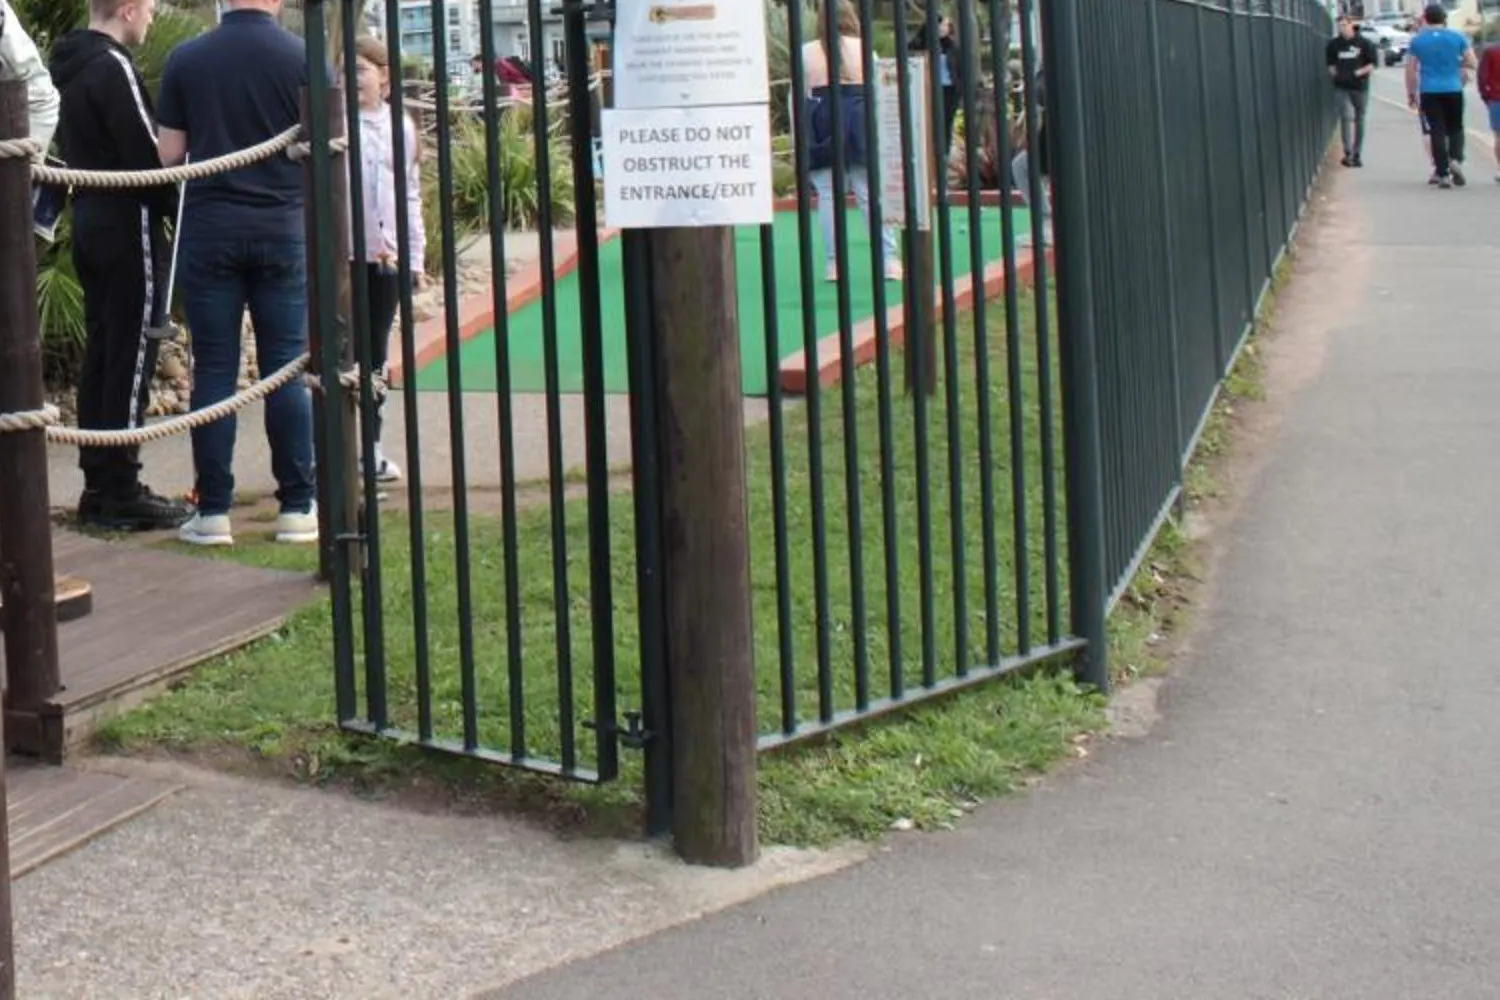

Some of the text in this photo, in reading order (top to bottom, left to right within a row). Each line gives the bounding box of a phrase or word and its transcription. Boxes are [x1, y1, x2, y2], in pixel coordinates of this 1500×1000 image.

[619, 125, 754, 144] PLEASE DO NOT
[623, 153, 751, 173] OBSTRUCT THE
[619, 182, 757, 201] ENTRANCE/EXIT
